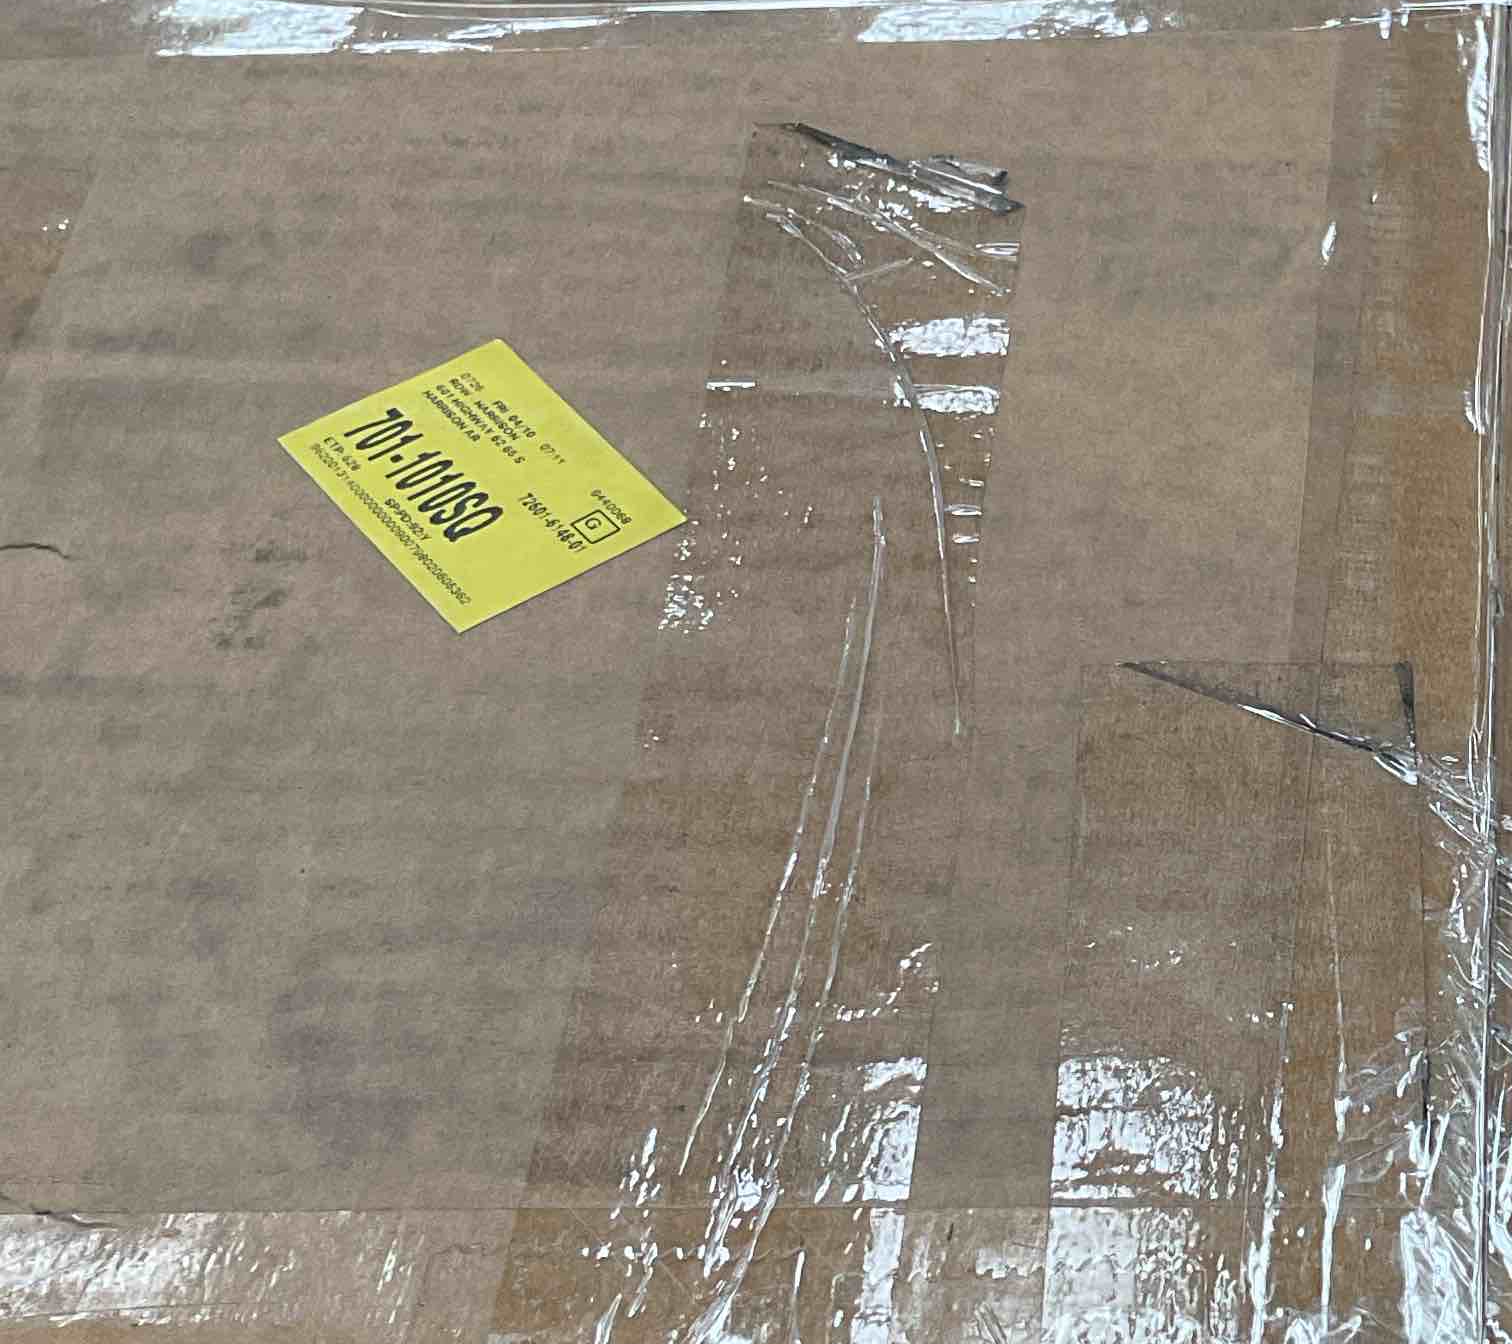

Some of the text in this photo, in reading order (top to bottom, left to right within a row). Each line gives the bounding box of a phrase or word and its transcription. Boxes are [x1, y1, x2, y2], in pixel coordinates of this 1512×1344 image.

[422, 389, 481, 443] HARRISON AR
[474, 399, 520, 441] HARRISON
[492, 399, 511, 413] FRI
[452, 398, 495, 435] HIGHWAY
[513, 455, 526, 464] S
[584, 516, 602, 530] G
